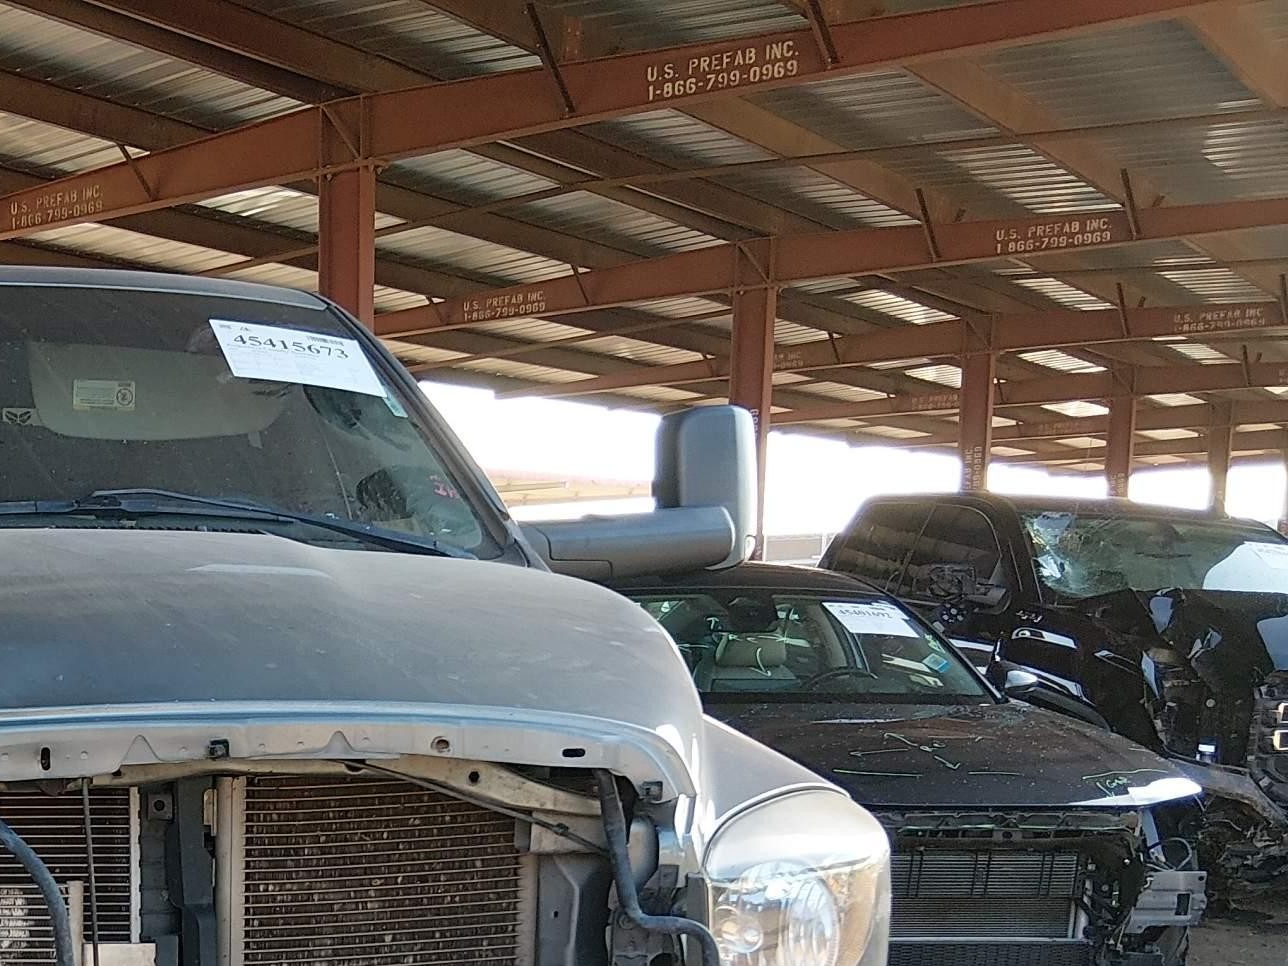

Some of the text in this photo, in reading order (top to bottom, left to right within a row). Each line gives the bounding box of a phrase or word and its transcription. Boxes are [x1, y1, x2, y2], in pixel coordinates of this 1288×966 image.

[647, 41, 800, 82] U.S. PREFAB INC.
[648, 60, 798, 101] 1-866-799-0969
[36, 190, 78, 209] PREFAB
[996, 218, 1112, 241] U.S. PREFAB INC.
[486, 295, 523, 308] PREFAB
[233, 334, 350, 359] 45415673
